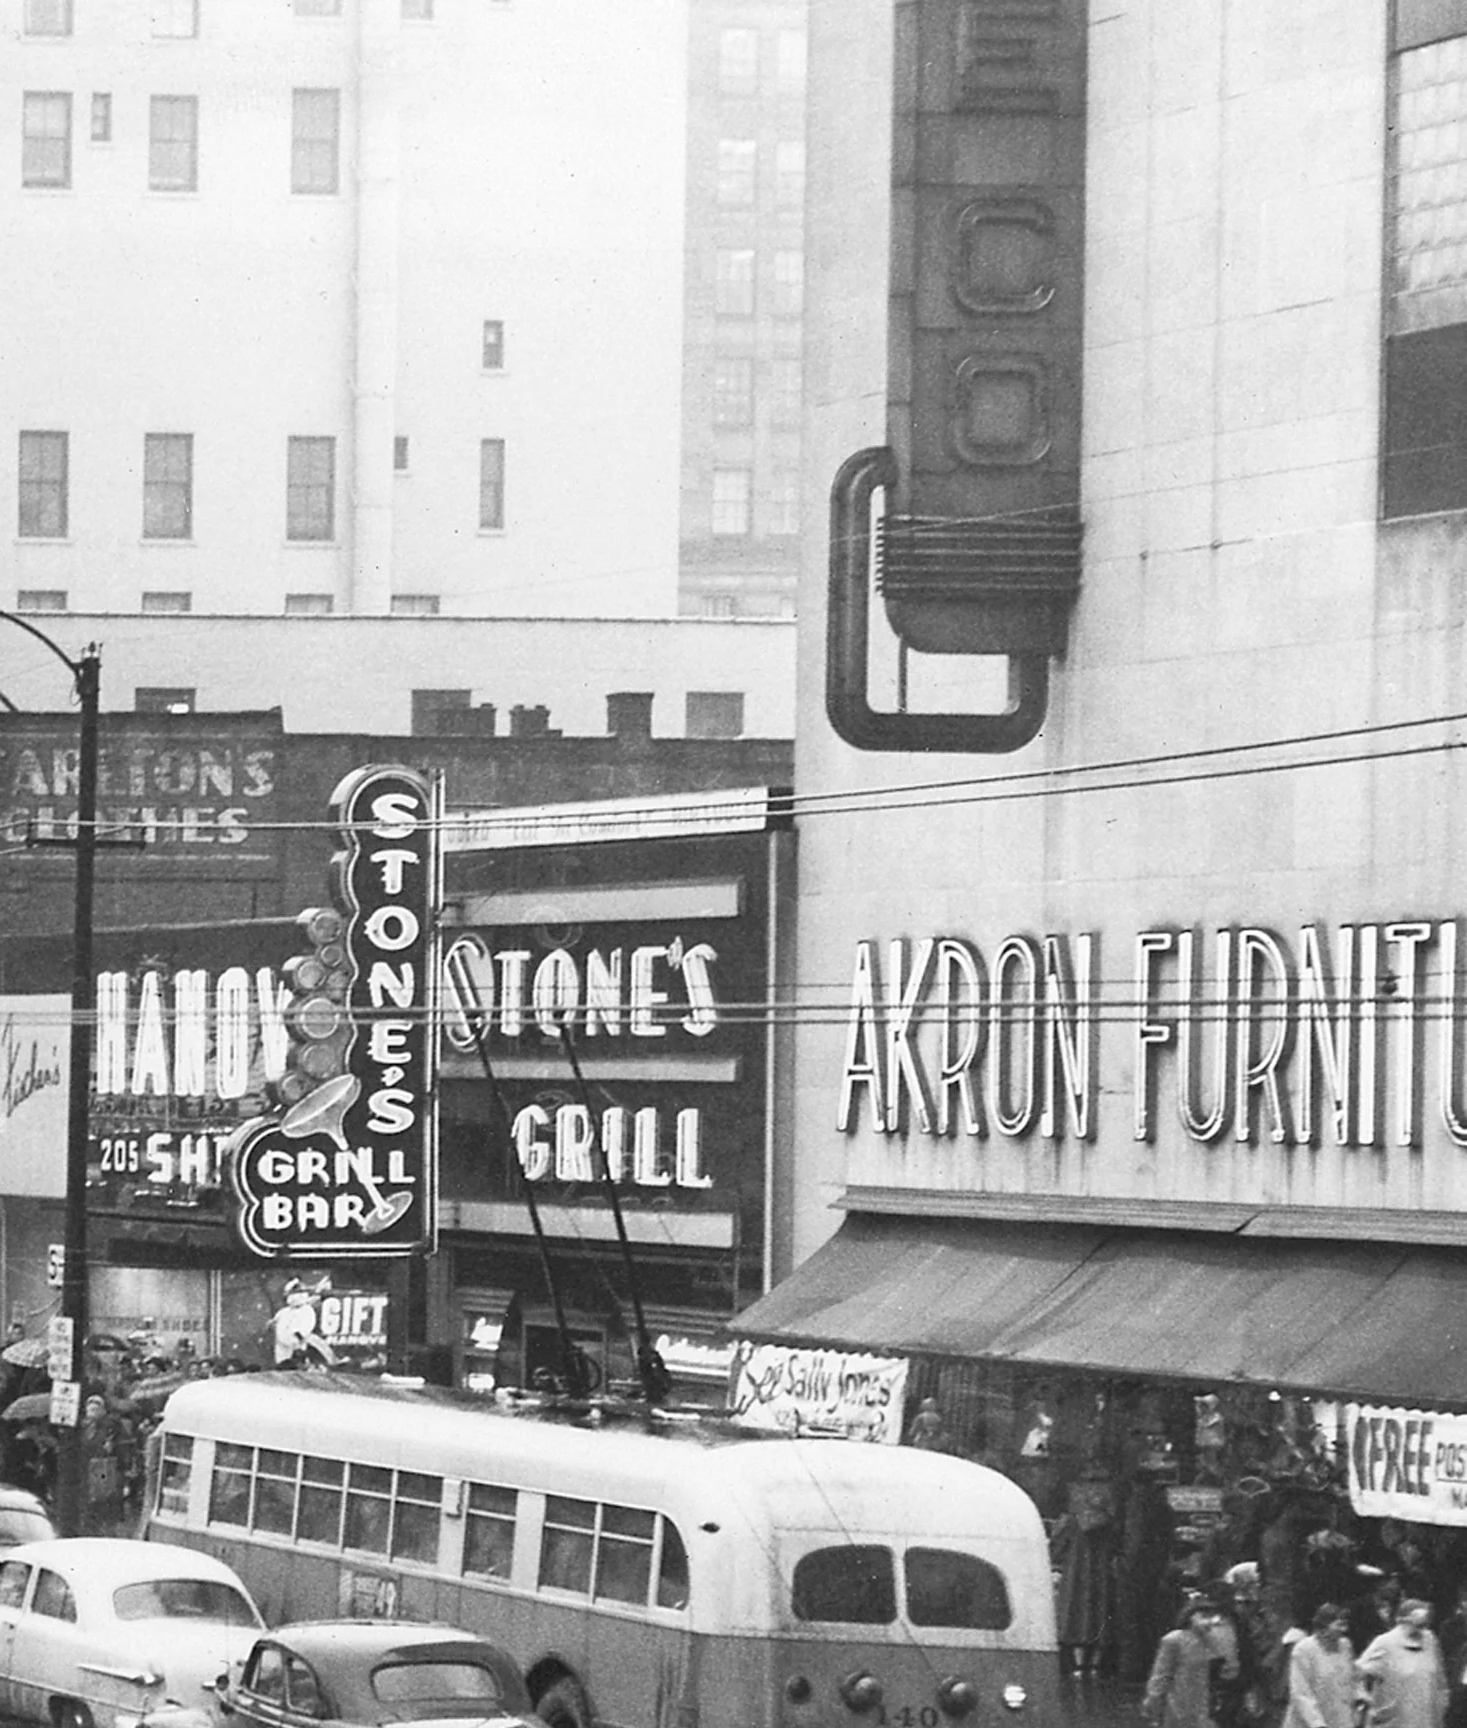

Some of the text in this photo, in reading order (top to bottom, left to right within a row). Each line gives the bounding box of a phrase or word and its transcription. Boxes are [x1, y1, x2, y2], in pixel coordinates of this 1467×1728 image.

[836, 932, 1092, 1139] AKRON
[100, 1138, 140, 1173] 205
[262, 1194, 369, 1232] BAR
[320, 1297, 389, 1336] GIFT
